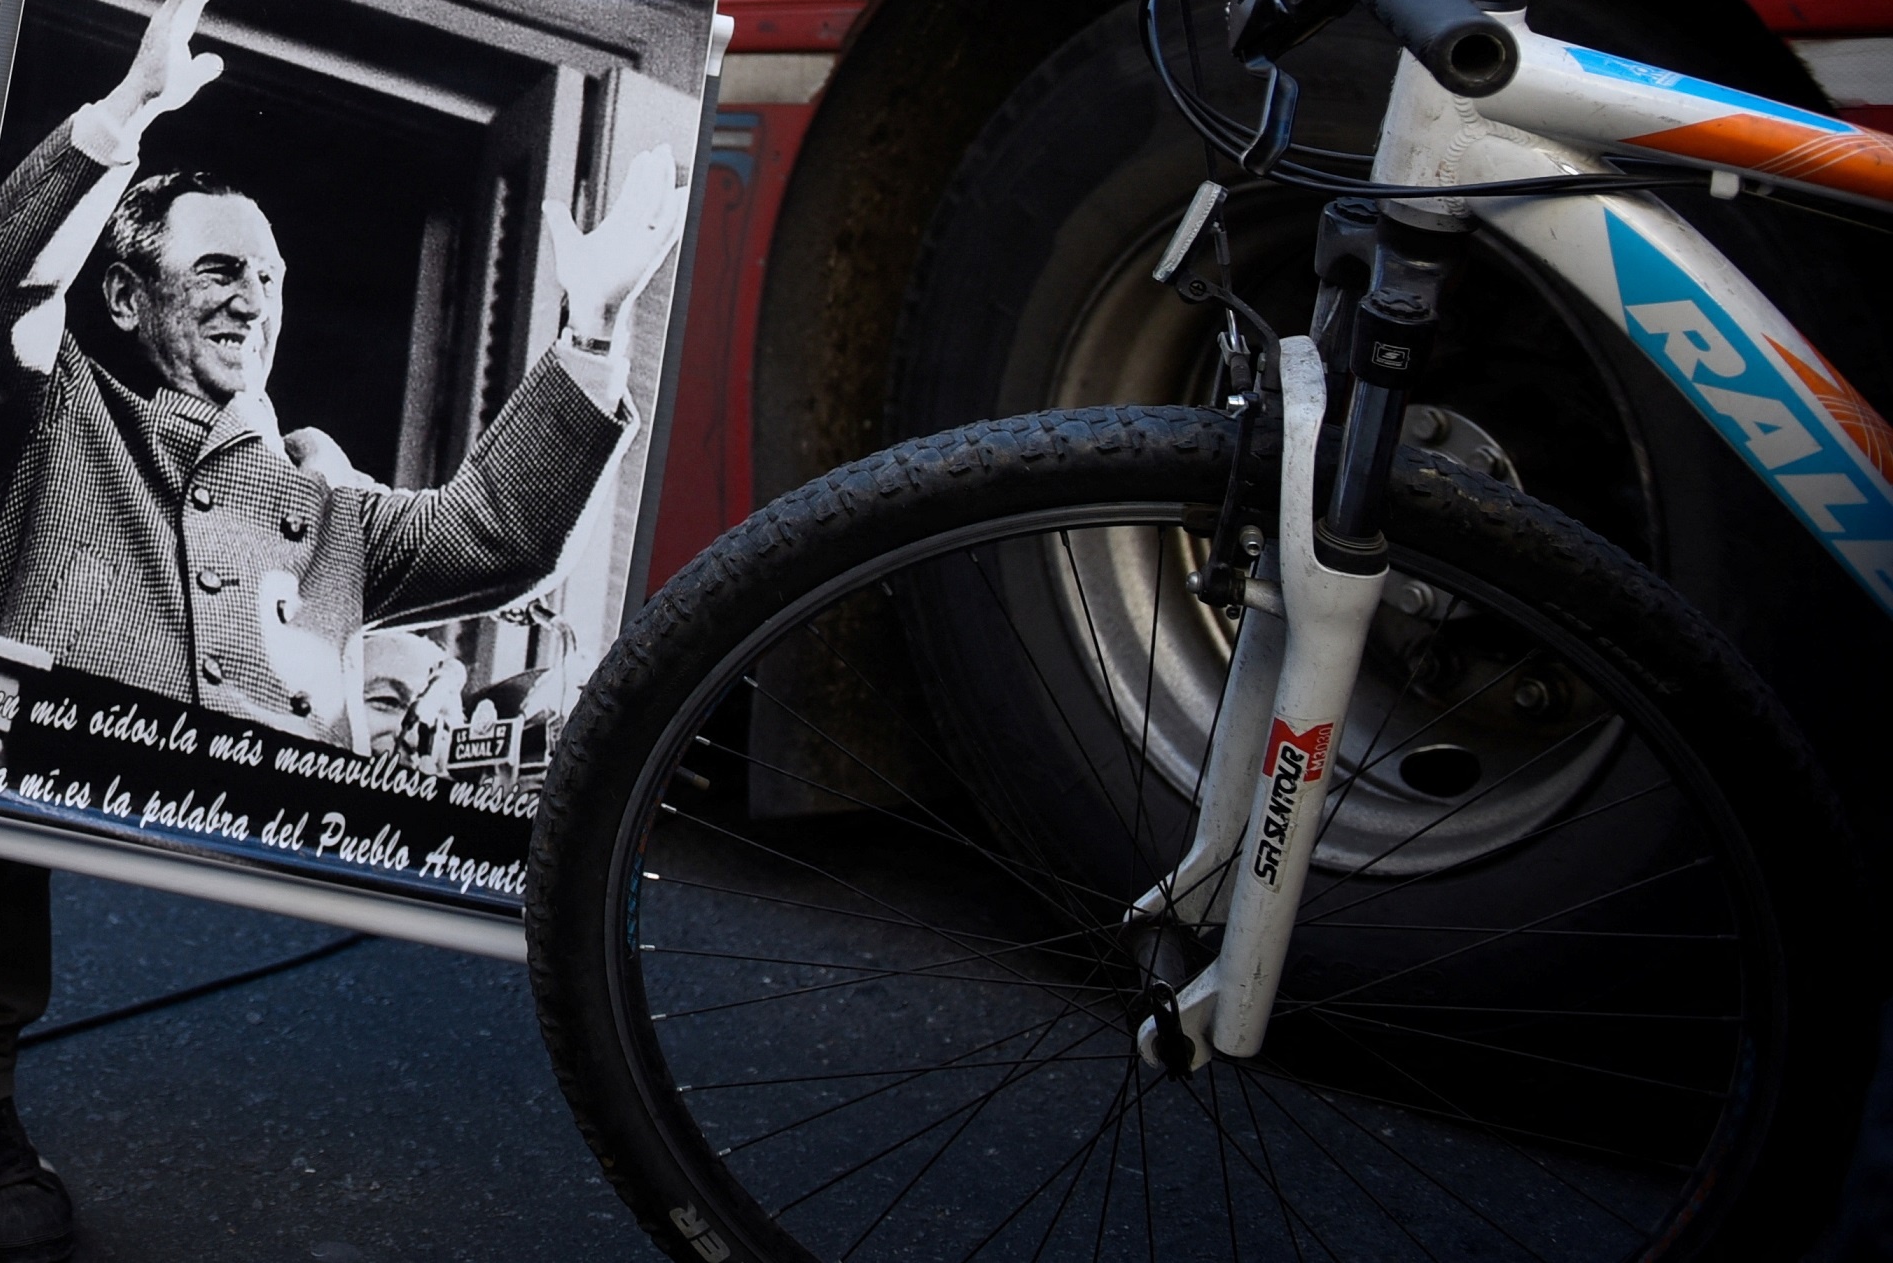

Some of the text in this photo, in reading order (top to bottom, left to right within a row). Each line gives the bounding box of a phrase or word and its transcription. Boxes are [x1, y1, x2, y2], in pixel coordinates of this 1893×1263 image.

[30, 697, 78, 731] mis
[208, 730, 264, 767] más
[274, 745, 439, 802] maravillosa
[454, 739, 505, 760] CANAL 7
[102, 774, 132, 818] la
[139, 790, 251, 843] palabra
[261, 808, 310, 852] del
[316, 811, 410, 872] Pueblo
[418, 835, 528, 896] Argenti
